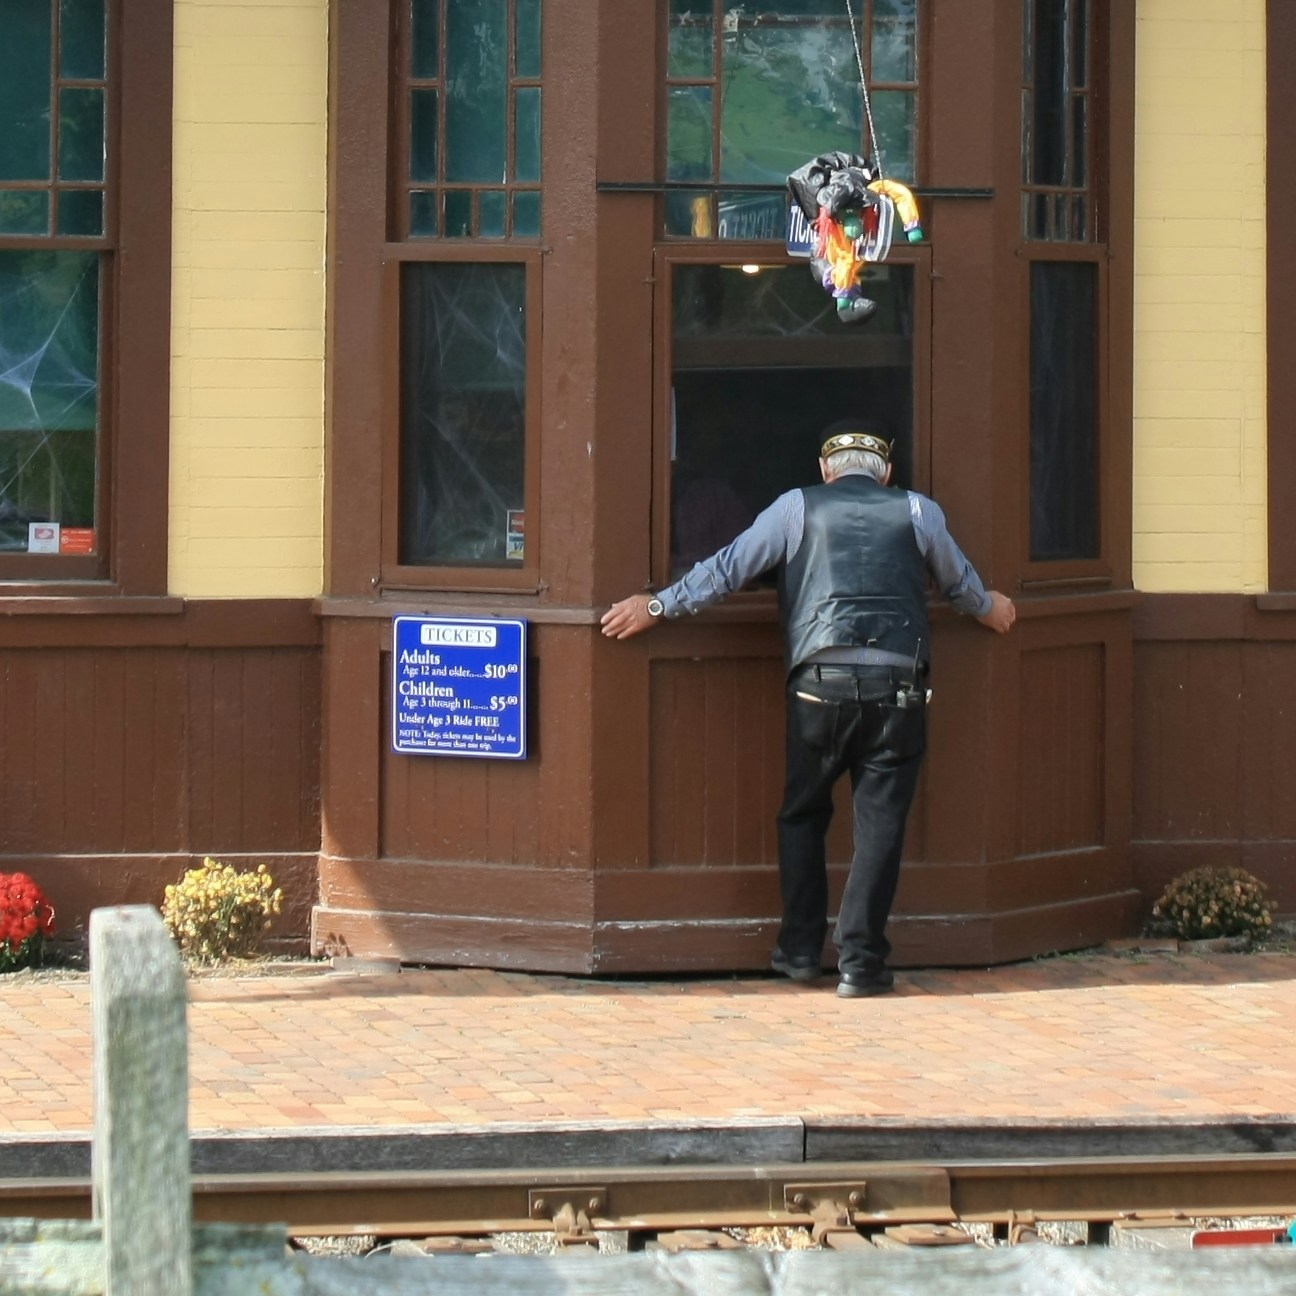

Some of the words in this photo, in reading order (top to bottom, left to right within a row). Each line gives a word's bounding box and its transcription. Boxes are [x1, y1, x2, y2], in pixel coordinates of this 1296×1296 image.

[425, 627, 493, 644] TICKETS
[399, 649, 441, 665] Adults
[403, 665, 419, 678] Age
[421, 665, 430, 676] 12
[431, 665, 447, 677] and
[399, 680, 454, 697] Children
[403, 696, 419, 710] Age
[421, 697, 426, 708] 3
[428, 697, 461, 711] through
[399, 712, 425, 724] Under
[427, 713, 443, 727] Age
[445, 715, 451, 726] 3
[453, 715, 472, 727] Ride
[474, 716, 500, 727] FREE
